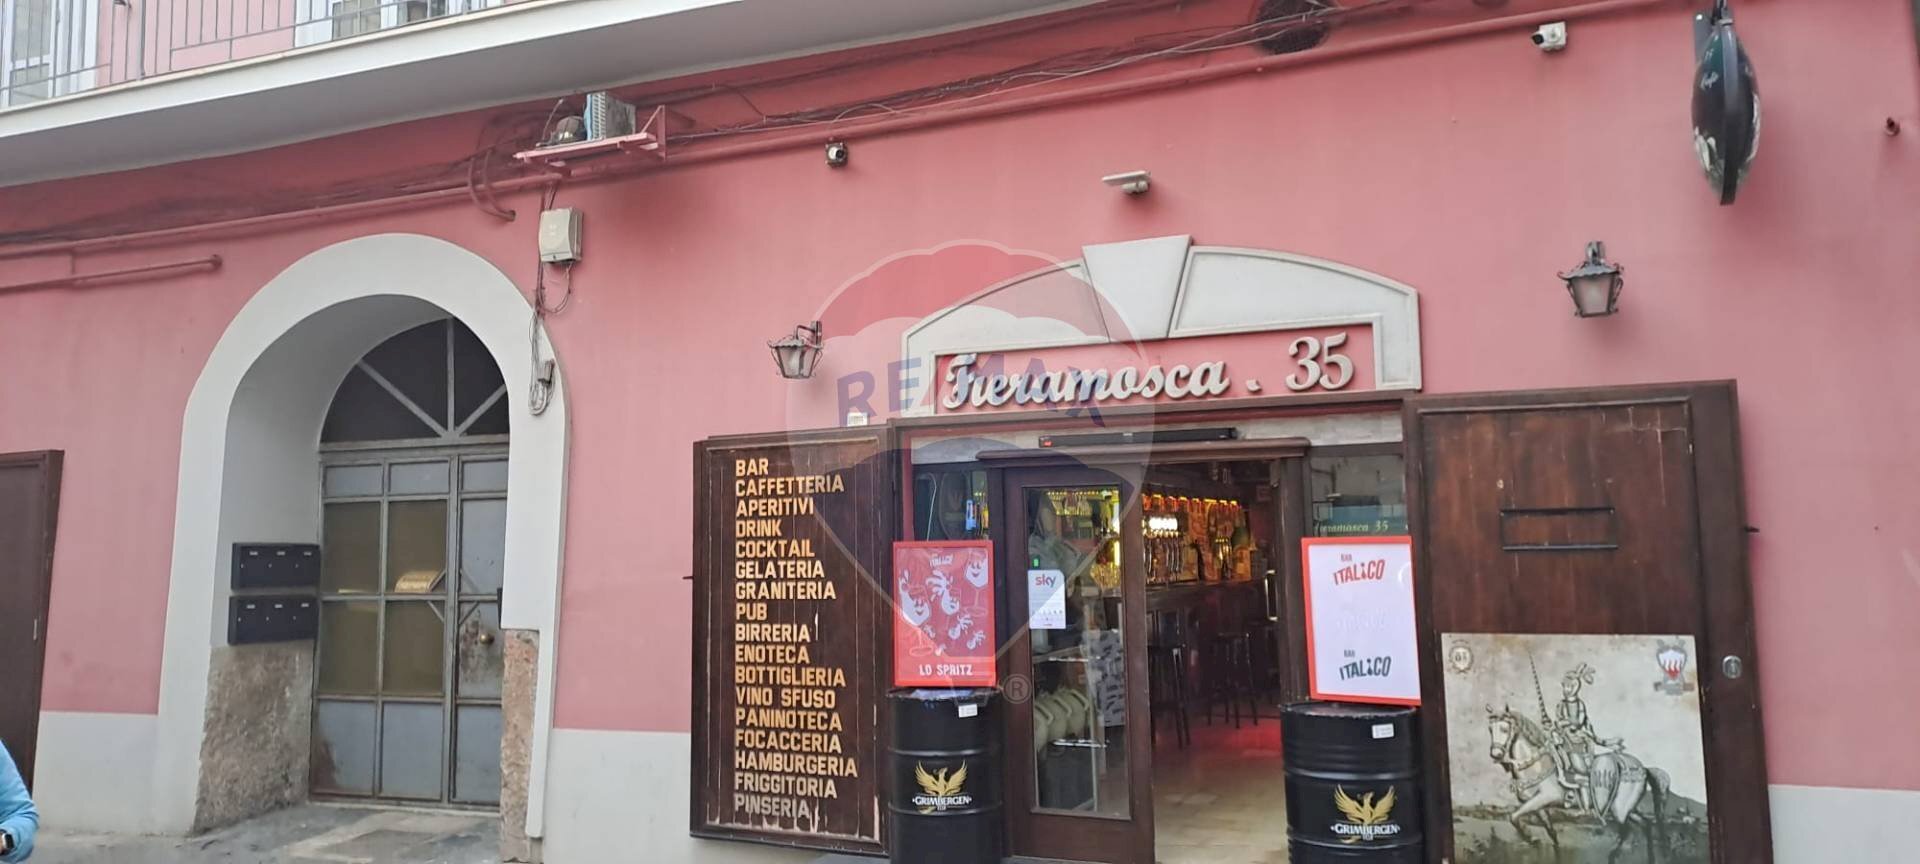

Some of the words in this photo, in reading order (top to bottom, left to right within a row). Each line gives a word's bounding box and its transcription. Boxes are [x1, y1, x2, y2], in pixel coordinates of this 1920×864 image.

[943, 353, 1231, 410] Fieramosca
[1285, 332, 1354, 391] 35
[736, 458, 769, 476] BAR
[736, 474, 845, 497] CAFFETTERIA
[736, 497, 814, 517] APERITIVI
[736, 519, 782, 538] DRINK
[736, 539, 815, 558] COCKTAIL
[736, 560, 825, 579] GELATERIA
[1035, 573, 1057, 588] sky
[736, 581, 837, 600] GRANITERIA
[736, 603, 767, 621] PUB
[736, 623, 811, 643] BIRRERIA
[735, 645, 810, 664] ENOTECA
[735, 666, 846, 687] BOTTIGLIERIA
[919, 664, 932, 676] LO
[936, 664, 974, 676] SPRITZ
[735, 687, 773, 706] VINO
[781, 687, 836, 709] SFUSO
[735, 708, 843, 731] PANINOTECA
[735, 729, 842, 754] FOCACCERIA
[735, 750, 858, 778] HAMBURGERIA
[734, 772, 838, 798] FRIGGITORIA
[734, 793, 811, 818] PINSERIA
[914, 796, 971, 806] GRIMBERGEN
[1334, 823, 1399, 836] GRIMBERGEN
